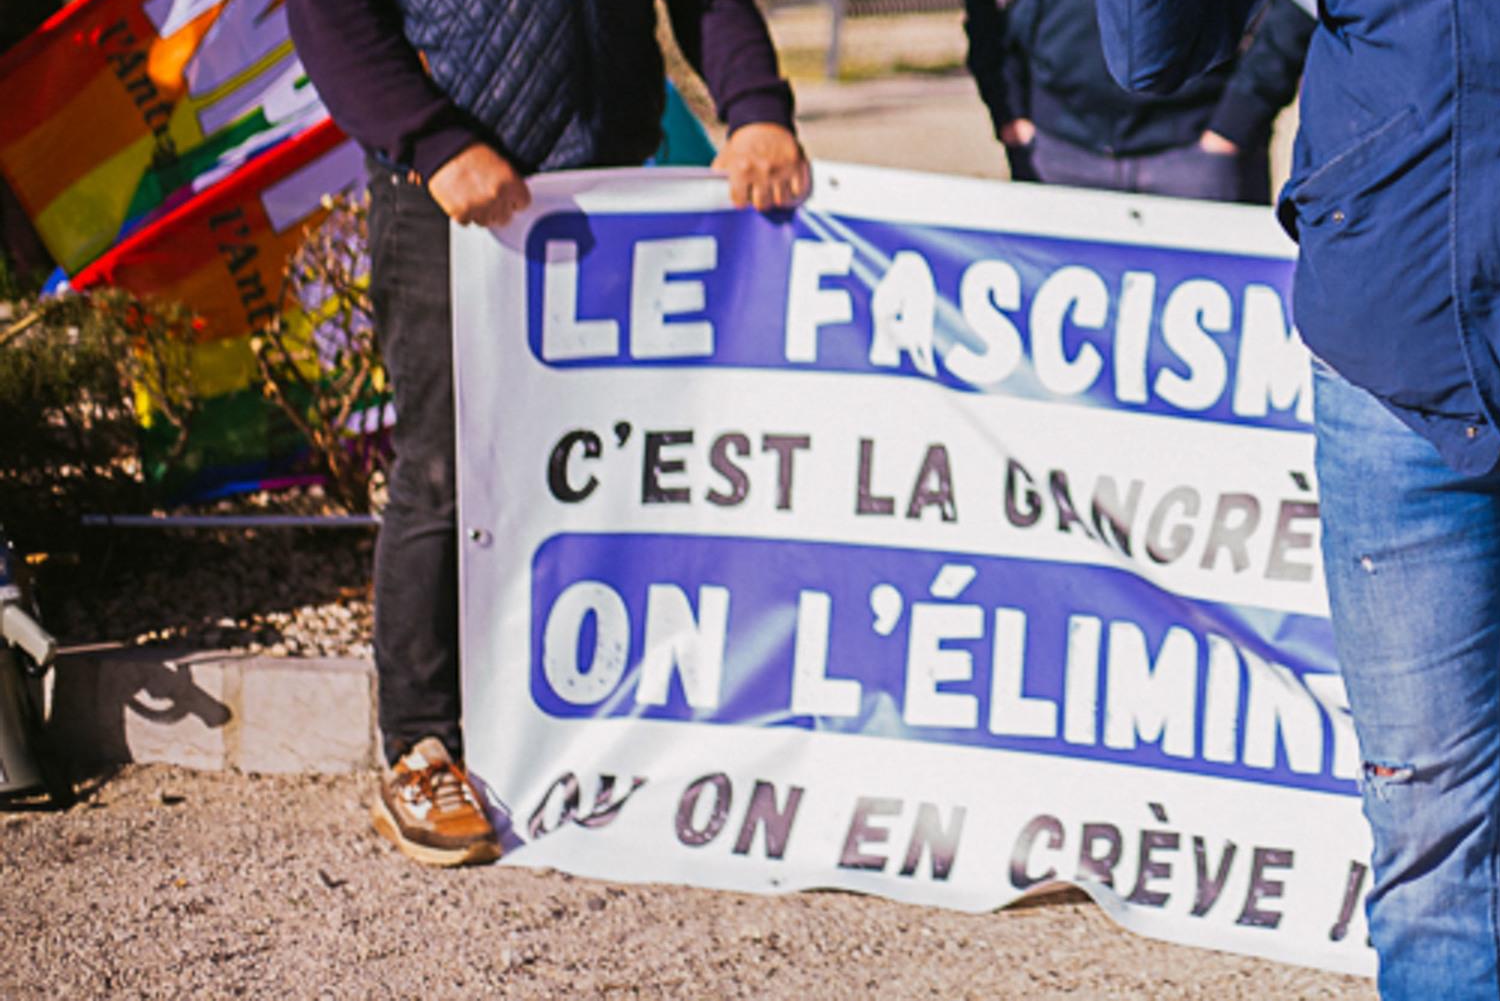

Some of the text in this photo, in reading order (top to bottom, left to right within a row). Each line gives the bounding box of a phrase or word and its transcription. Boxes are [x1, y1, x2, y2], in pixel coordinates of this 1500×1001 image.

[542, 237, 718, 361] LE
[547, 421, 810, 511] C'EST
[855, 439, 958, 523] LA
[543, 580, 730, 709] ON
[528, 771, 648, 840] OU
[675, 771, 805, 860] ON
[837, 796, 966, 881] EN
[1008, 803, 1294, 929] CRÈVE
